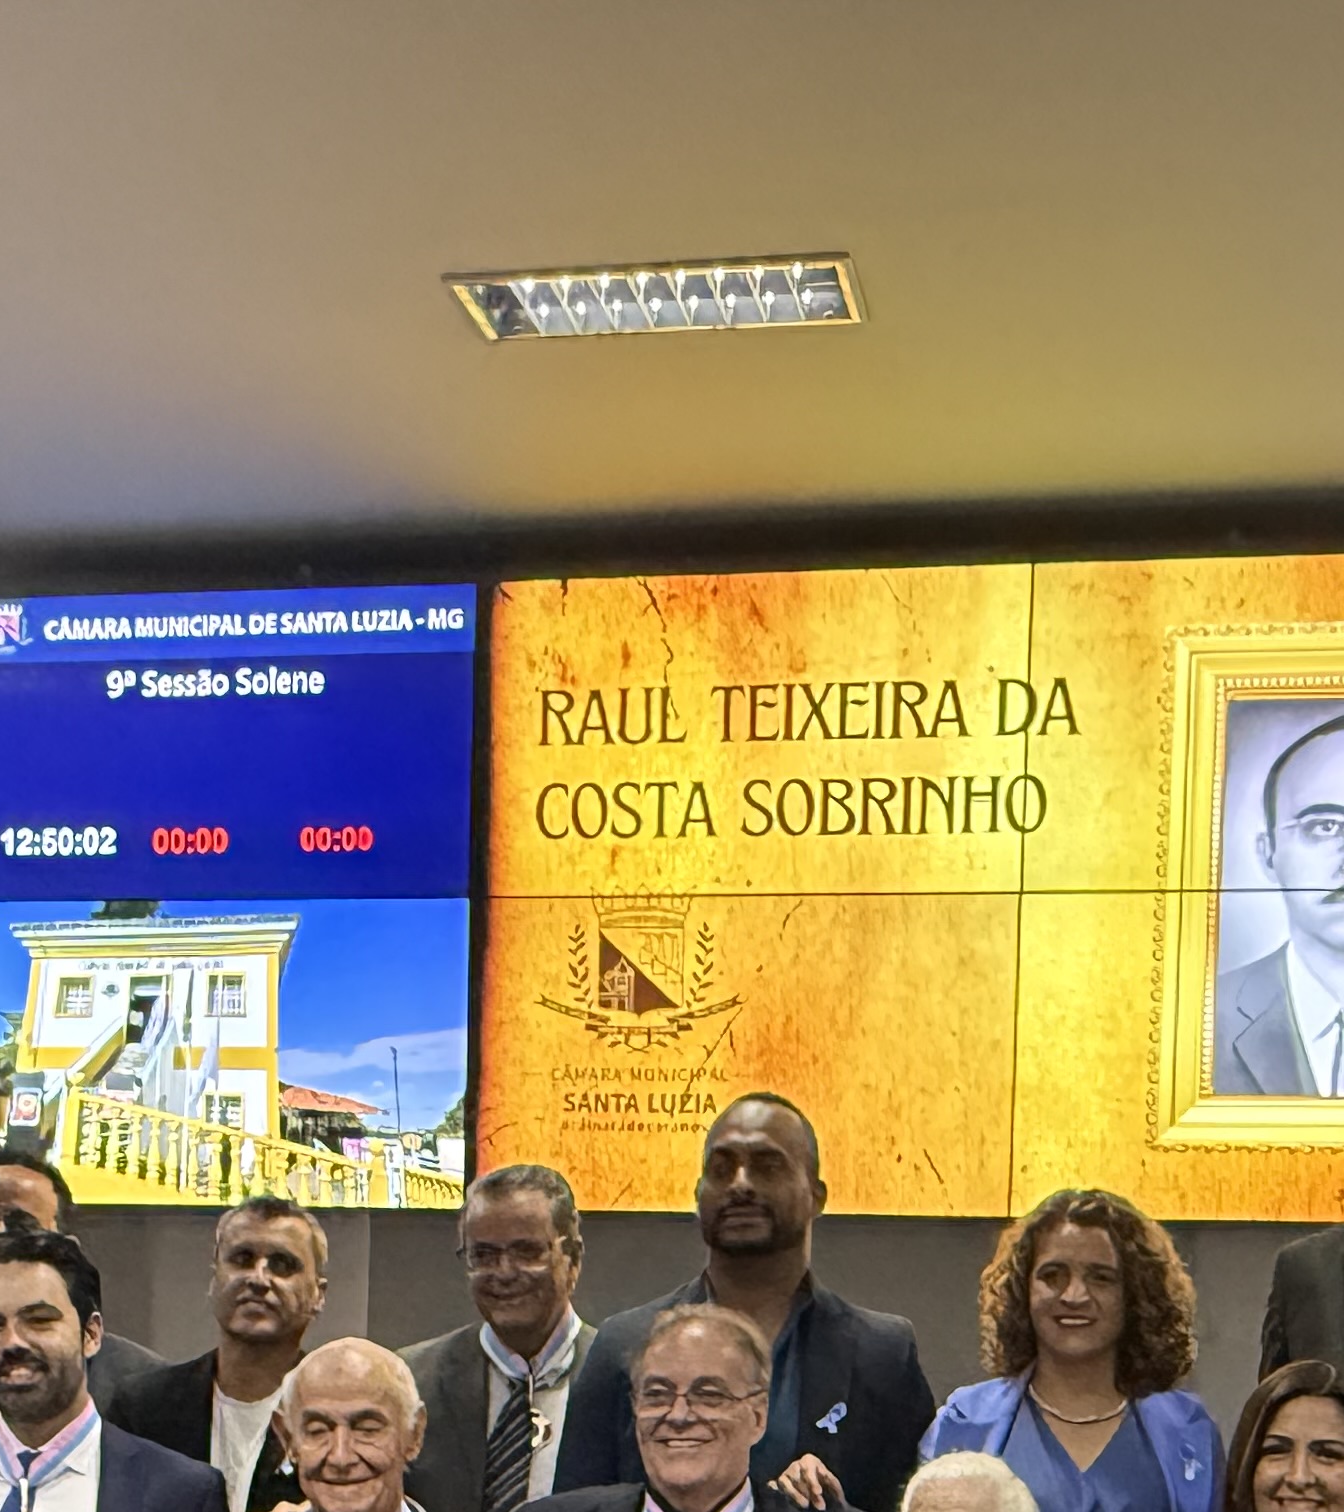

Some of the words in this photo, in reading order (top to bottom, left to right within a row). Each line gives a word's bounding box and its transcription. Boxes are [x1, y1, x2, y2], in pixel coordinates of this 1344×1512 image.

[43, 615, 132, 641] CÂMARA
[134, 614, 247, 638] MUNICIPAL
[248, 612, 278, 635] DE
[279, 611, 348, 634] SANTA
[351, 608, 413, 632] LUZIA
[427, 608, 465, 630] MG
[141, 668, 230, 698] Sessão
[235, 665, 325, 696] Solene
[538, 685, 687, 746] RAUL
[711, 680, 969, 743] TEIXEIRA
[993, 677, 1081, 737] DA
[535, 781, 718, 840] COSTA
[739, 774, 1048, 837] SOBRINHO
[0, 826, 117, 856] 12:50:02
[152, 827, 229, 854] 00:00
[300, 825, 374, 852] 00:00
[563, 1093, 640, 1114] SANTA
[647, 1093, 717, 1115] LUZIA
